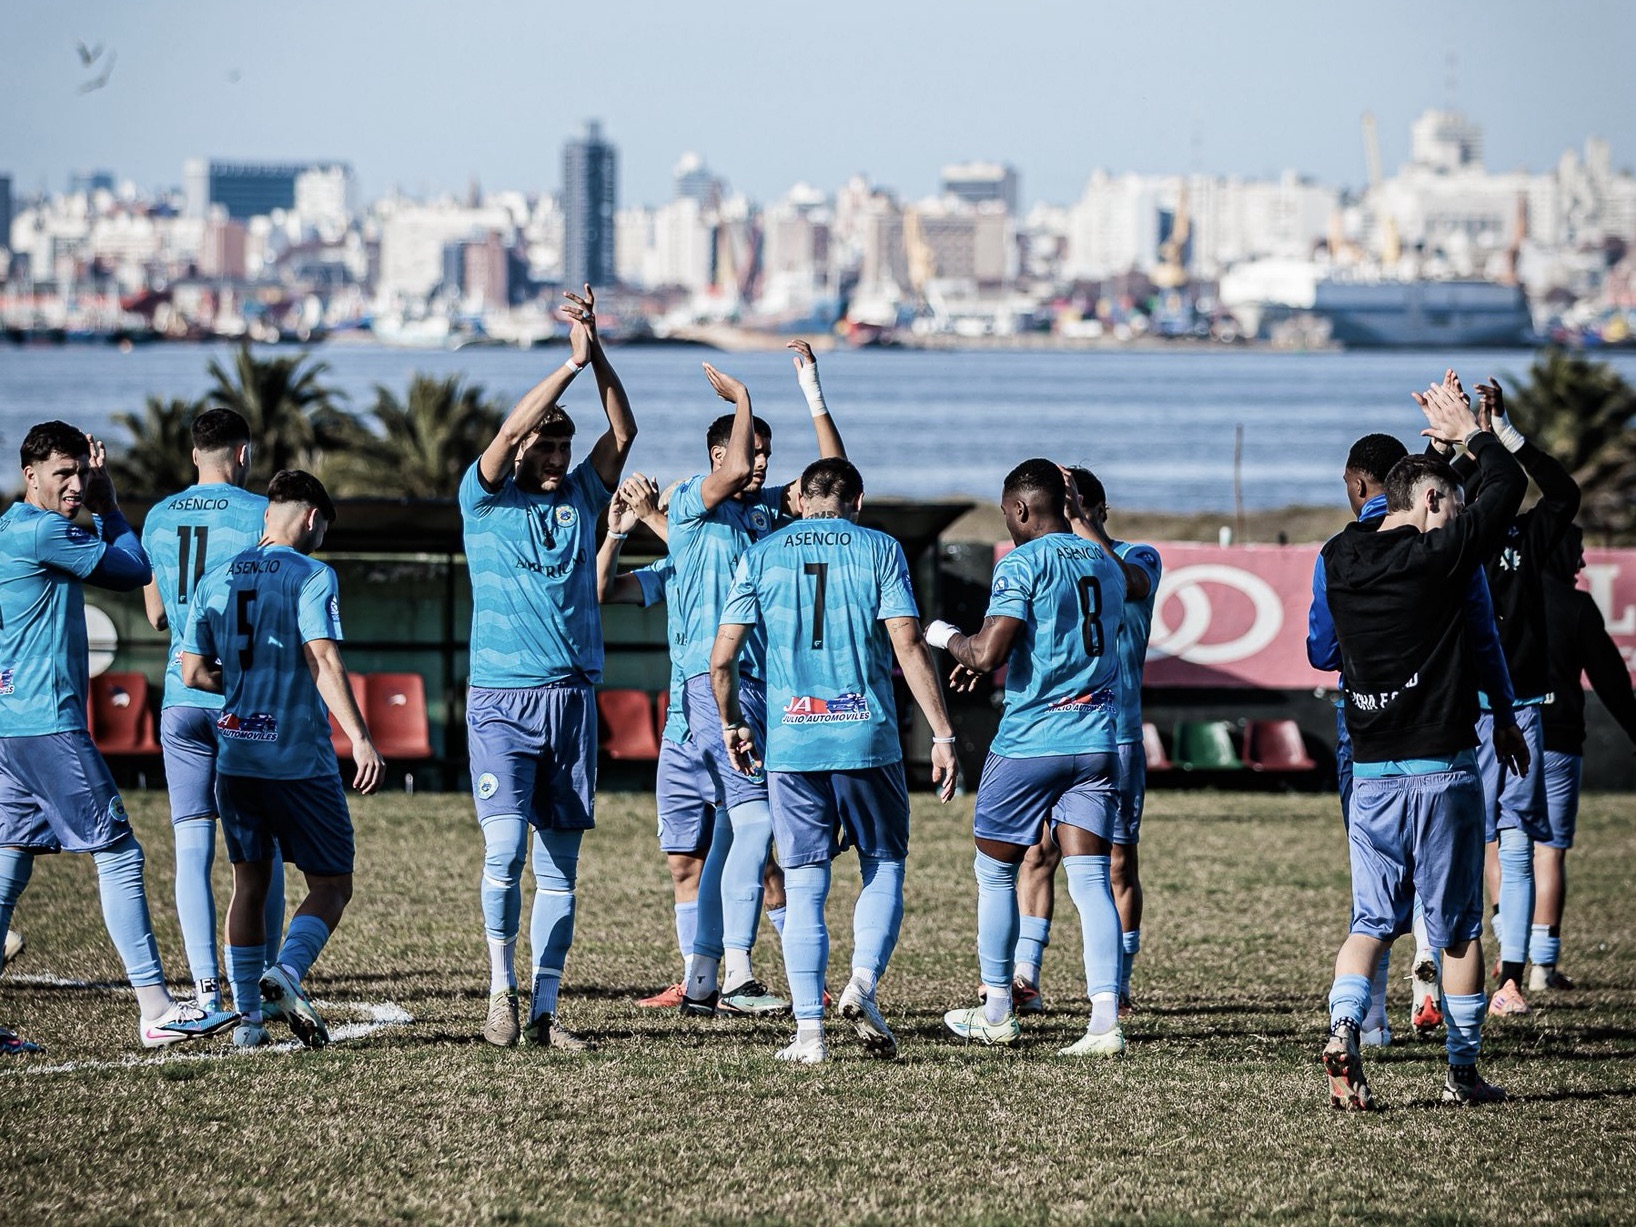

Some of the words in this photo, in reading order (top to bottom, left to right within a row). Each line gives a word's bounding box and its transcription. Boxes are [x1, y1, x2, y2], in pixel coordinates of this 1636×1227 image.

[168, 498, 229, 511] ASENCIO
[784, 532, 852, 548] ASENCIO
[1056, 546, 1104, 560] ASENCIO
[177, 526, 208, 604] 11
[226, 560, 280, 576] ASENCIO
[804, 562, 828, 650] 7
[1078, 576, 1104, 657] 8
[237, 588, 258, 671] 5
[783, 696, 811, 712] JA
[783, 714, 805, 724] JULIO
[806, 711, 870, 723] AUTOMOVILES
